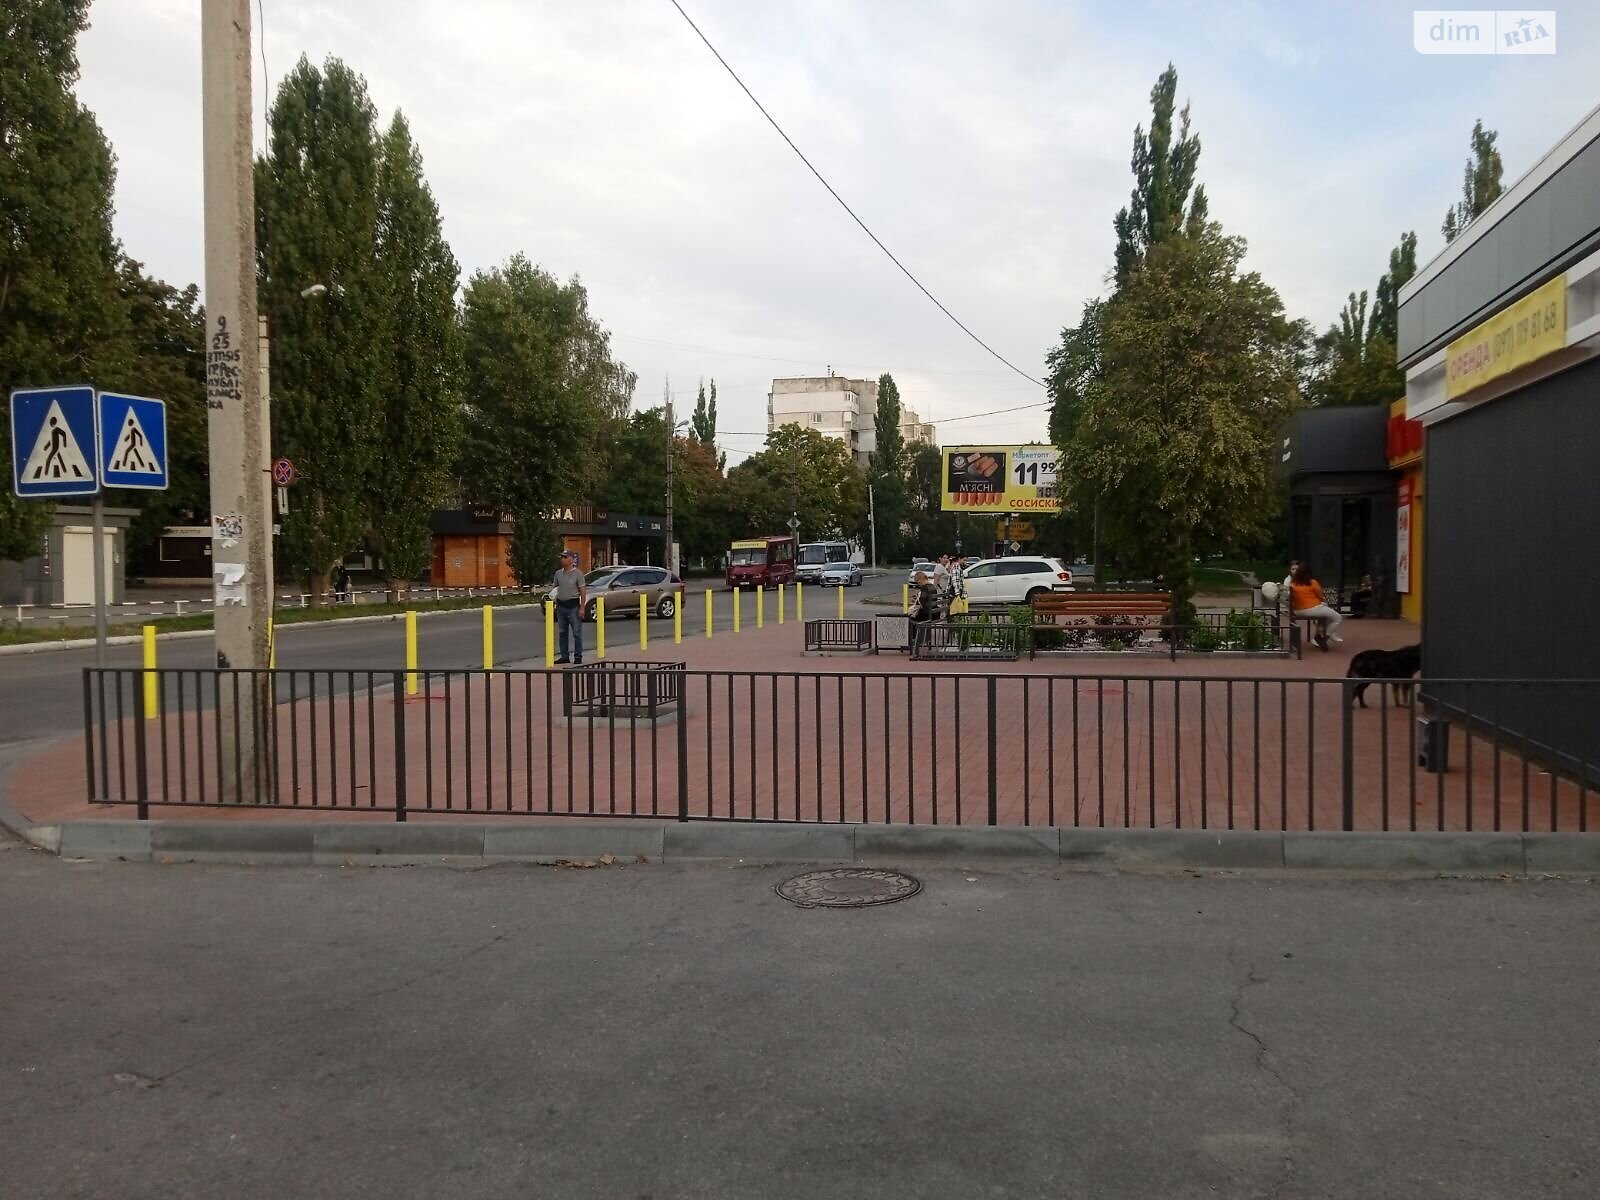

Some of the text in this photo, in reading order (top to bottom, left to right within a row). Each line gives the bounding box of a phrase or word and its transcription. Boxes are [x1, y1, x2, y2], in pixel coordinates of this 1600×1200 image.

[217, 315, 227, 332] 9
[212, 335, 230, 350] 25
[1450, 341, 1490, 382] ОРЕНДА
[1544, 301, 1557, 332] 68
[1014, 462, 1038, 485] 11
